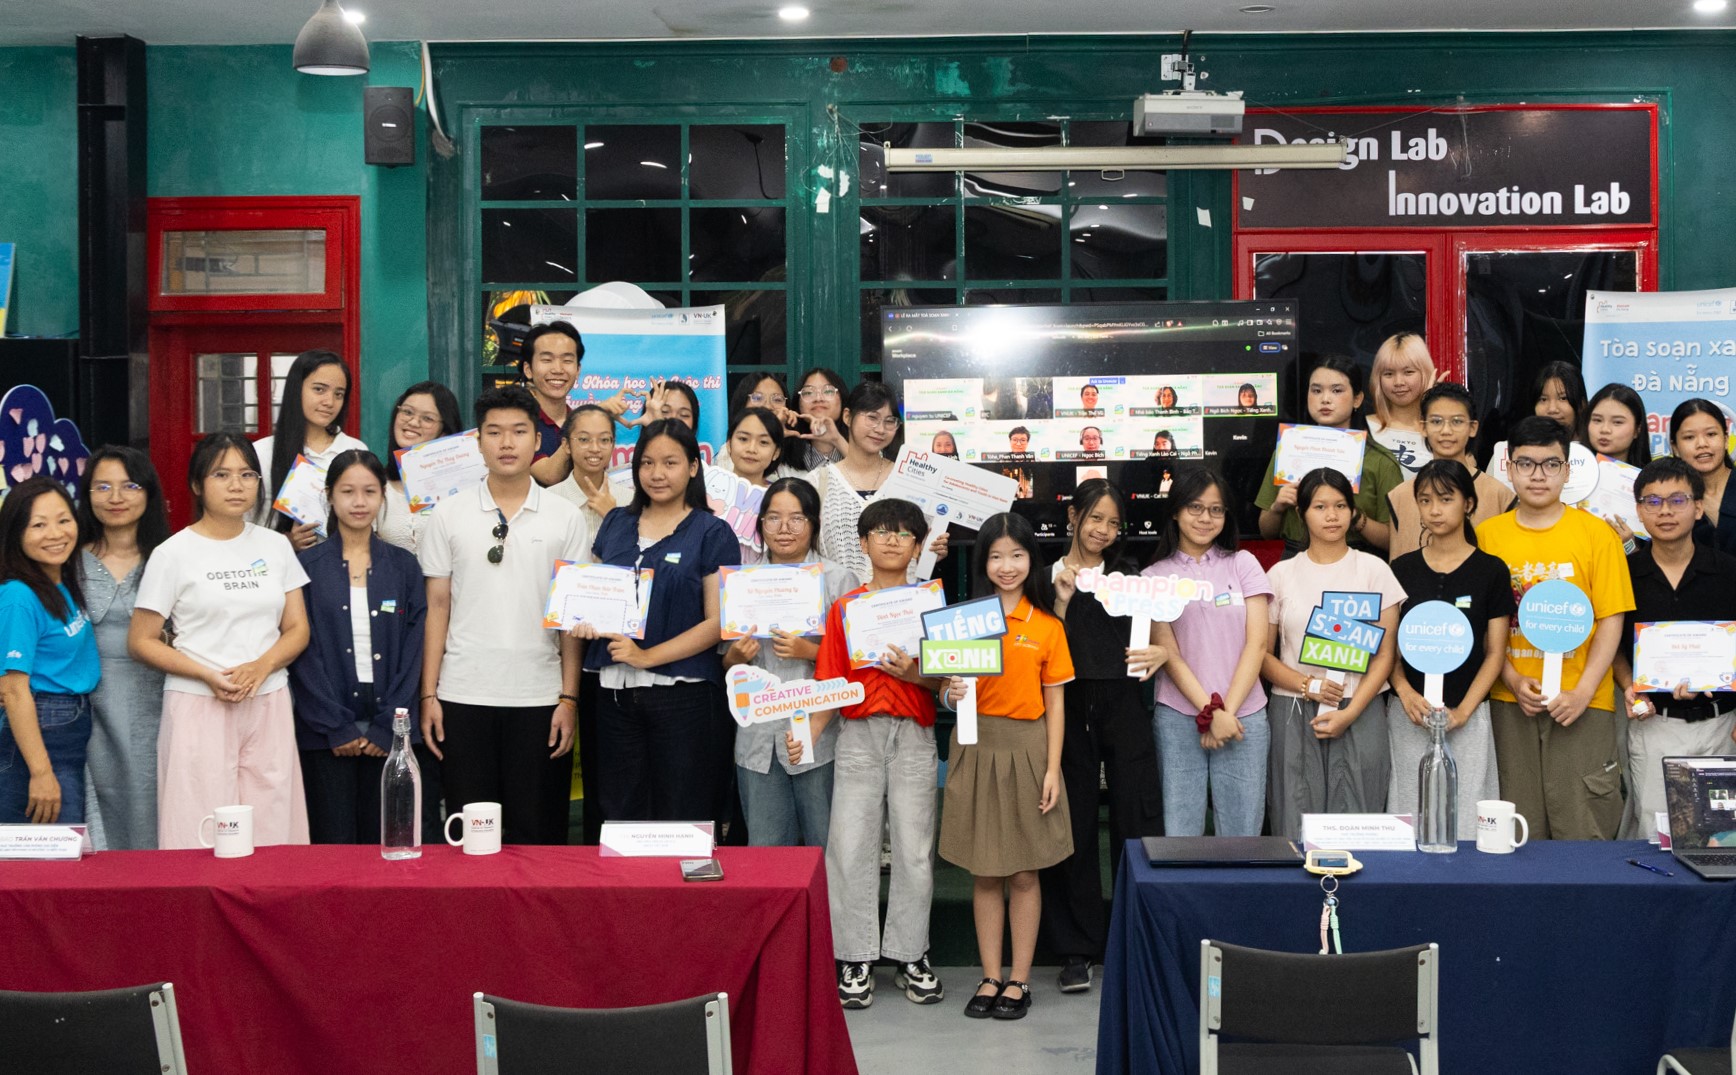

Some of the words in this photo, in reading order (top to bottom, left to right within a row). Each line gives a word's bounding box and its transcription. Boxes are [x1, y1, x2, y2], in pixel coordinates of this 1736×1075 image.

[1391, 127, 1448, 161] Lab
[1388, 170, 1563, 216] Innovation
[1574, 182, 1630, 215] Lab
[1600, 338, 1639, 357] Tòa
[1645, 339, 1701, 361] soạn
[582, 375, 620, 390] Khóa
[703, 375, 721, 389] thi
[1632, 370, 1662, 392] Đà
[1669, 364, 1730, 397] Nẵng
[907, 466, 925, 477] Cities
[909, 459, 938, 474] Healthy
[224, 581, 259, 590] BRAIN
[1331, 595, 1372, 617] TÒA
[1526, 601, 1568, 614] unicef
[928, 609, 1001, 641] TIẾNG
[1405, 623, 1447, 636] unicef
[1526, 620, 1536, 628] for
[1539, 622, 1562, 633] every
[1564, 624, 1584, 633] child
[1305, 641, 1366, 667] XANH
[1405, 643, 1417, 652] for
[1418, 645, 1442, 656] every
[1444, 645, 1464, 655] child
[753, 685, 812, 704] CREATIVE
[754, 689, 859, 717] COMMUNICATION
